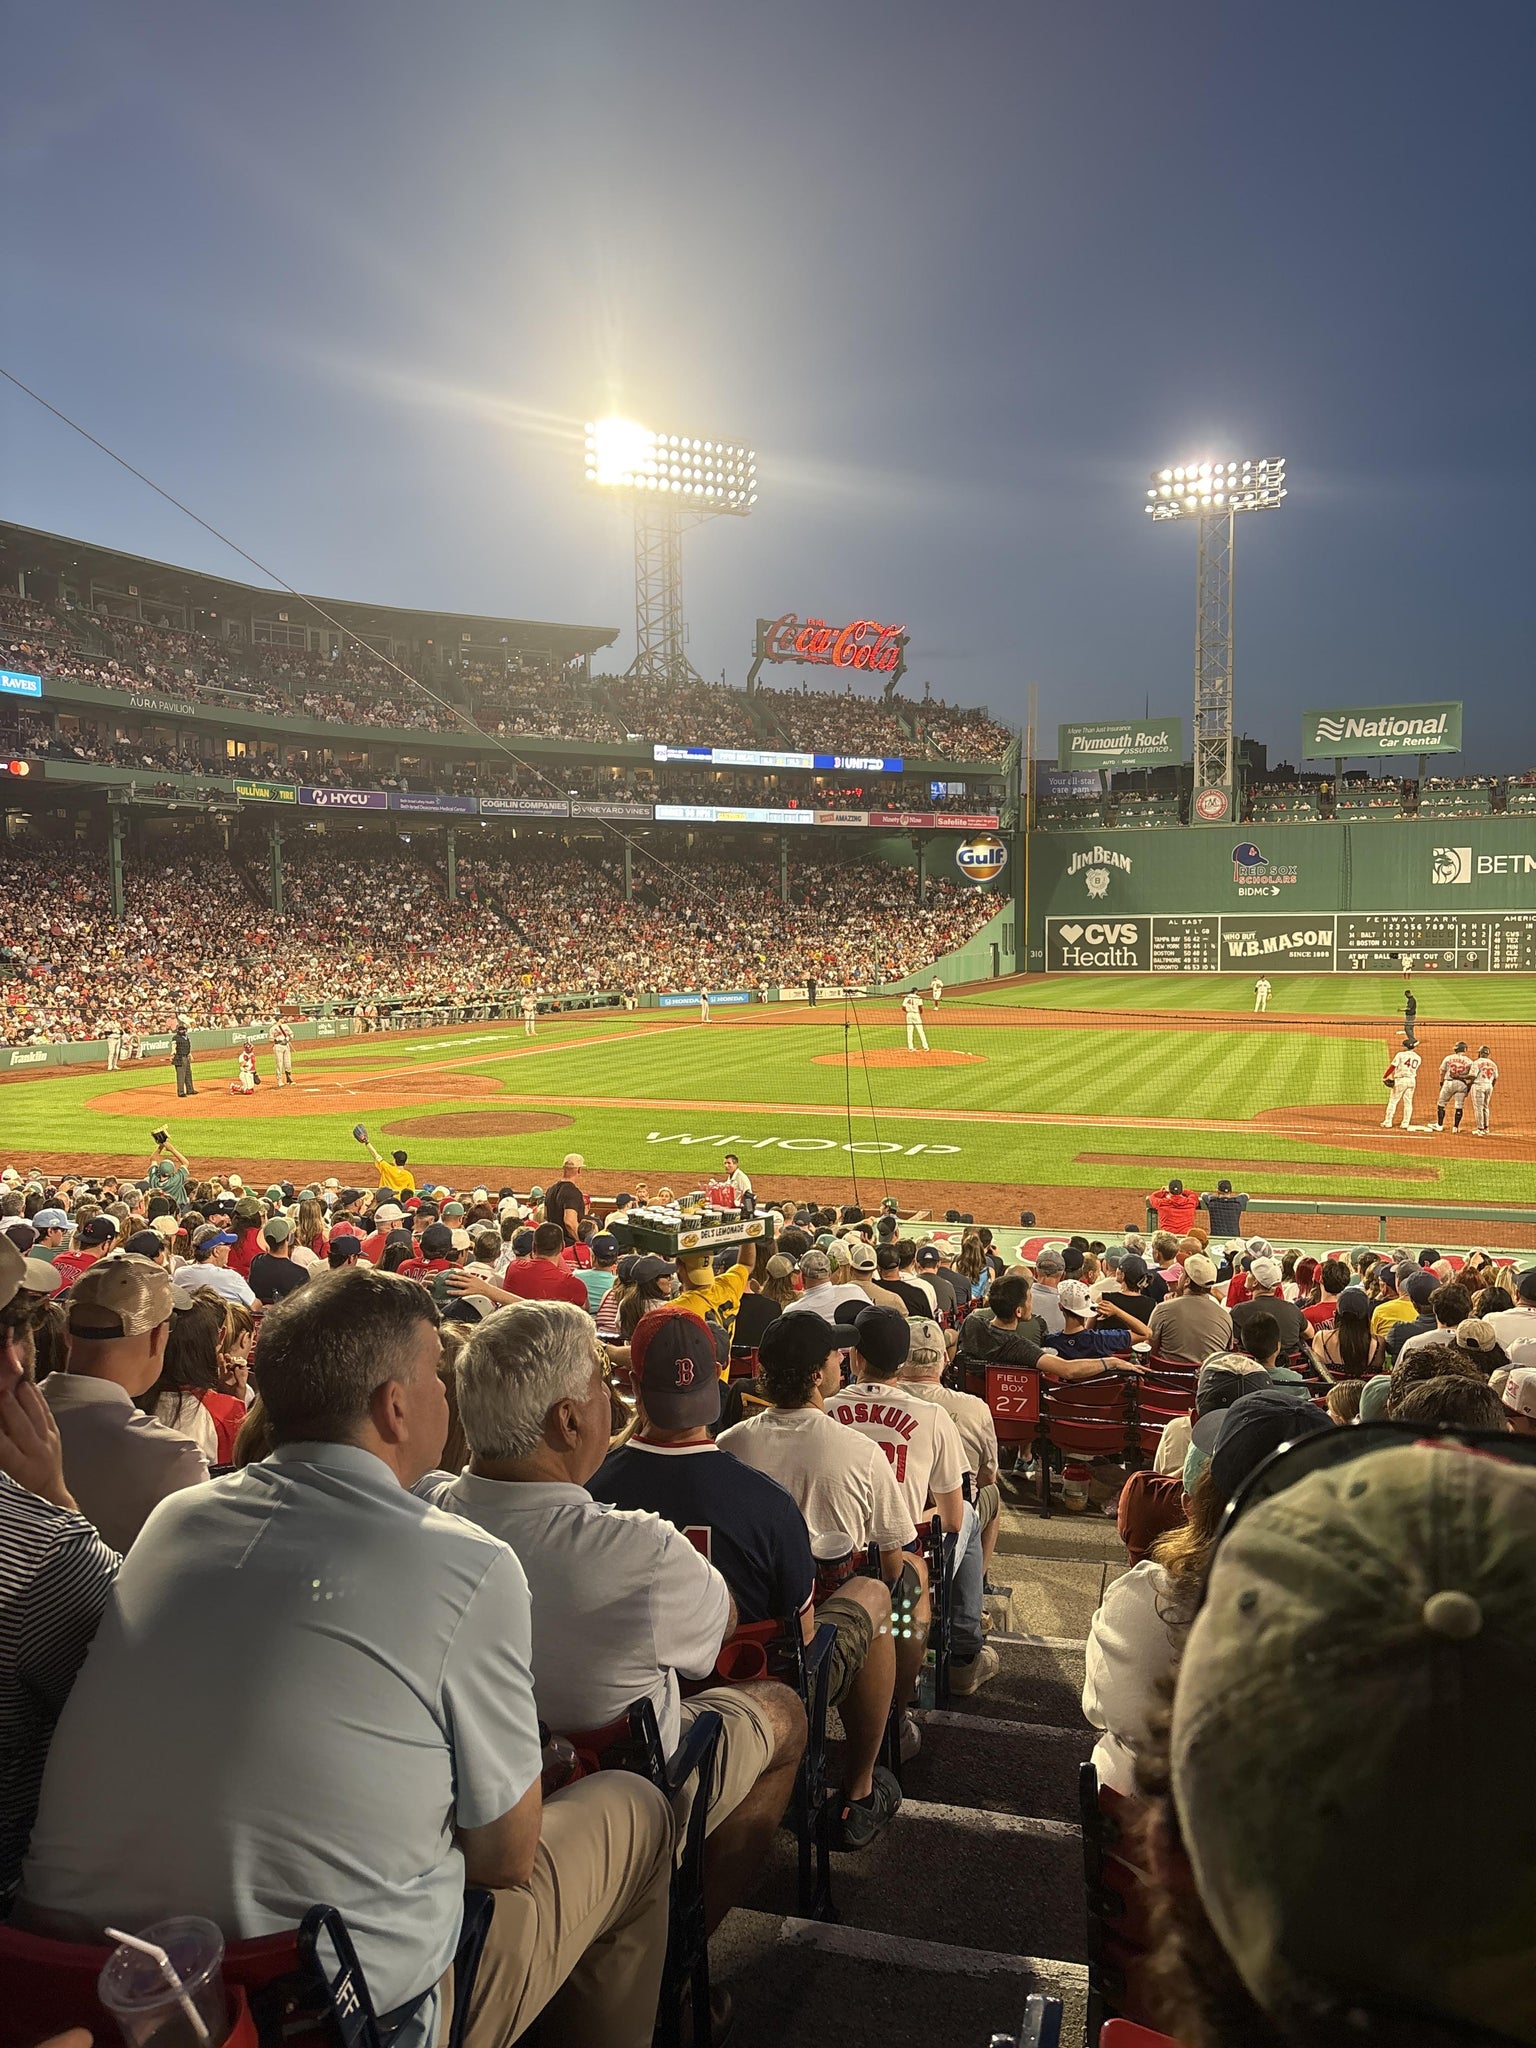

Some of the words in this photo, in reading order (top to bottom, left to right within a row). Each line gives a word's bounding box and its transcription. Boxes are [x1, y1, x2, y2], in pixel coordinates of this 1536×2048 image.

[766, 613, 905, 671] Coca-Cola
[2, 675, 37, 691] RAVEIS
[158, 702, 195, 715] PAVILION
[1345, 713, 1446, 738] National
[1071, 733, 1132, 751] Plymouth
[1135, 731, 1169, 747] Rock
[1379, 738, 1400, 748] Car
[1402, 736, 1440, 747] Rental
[1124, 745, 1169, 755] assurance
[845, 757, 884, 770] UNITED
[1049, 777, 1066, 785] Your
[236, 786, 270, 798] SULLIVAN
[279, 790, 294, 800] TIRE
[331, 792, 368, 805] HYCU
[482, 800, 518, 809] COGHLIN
[519, 801, 567, 810] COMPANIES
[835, 814, 862, 822] AMAZING
[882, 815, 899, 824] Ninety
[937, 818, 967, 826] Safelite
[960, 848, 1003, 865] Gulf
[1240, 866, 1266, 876] RED
[1270, 865, 1297, 875] SOX
[1239, 875, 1297, 884] SCHOLARS
[1238, 887, 1269, 896] BIDMC
[1085, 923, 1138, 945] CVS
[1030, 950, 1043, 958] 310
[1062, 946, 1138, 967] Health
[1351, 959, 1366, 969] 31
[246, 1033, 269, 1042] TICKET
[1404, 1057, 1419, 1069] 40
[646, 1132, 962, 1155] WHOOP
[701, 1229, 715, 1240] DEL'S
[715, 1224, 745, 1237] LEMONADE
[675, 1358, 695, 1386] B
[997, 1373, 1028, 1383] FIELD
[1001, 1383, 1024, 1393] BOX
[996, 1396, 1029, 1413] 27
[828, 1403, 919, 1441] OSKUIL
